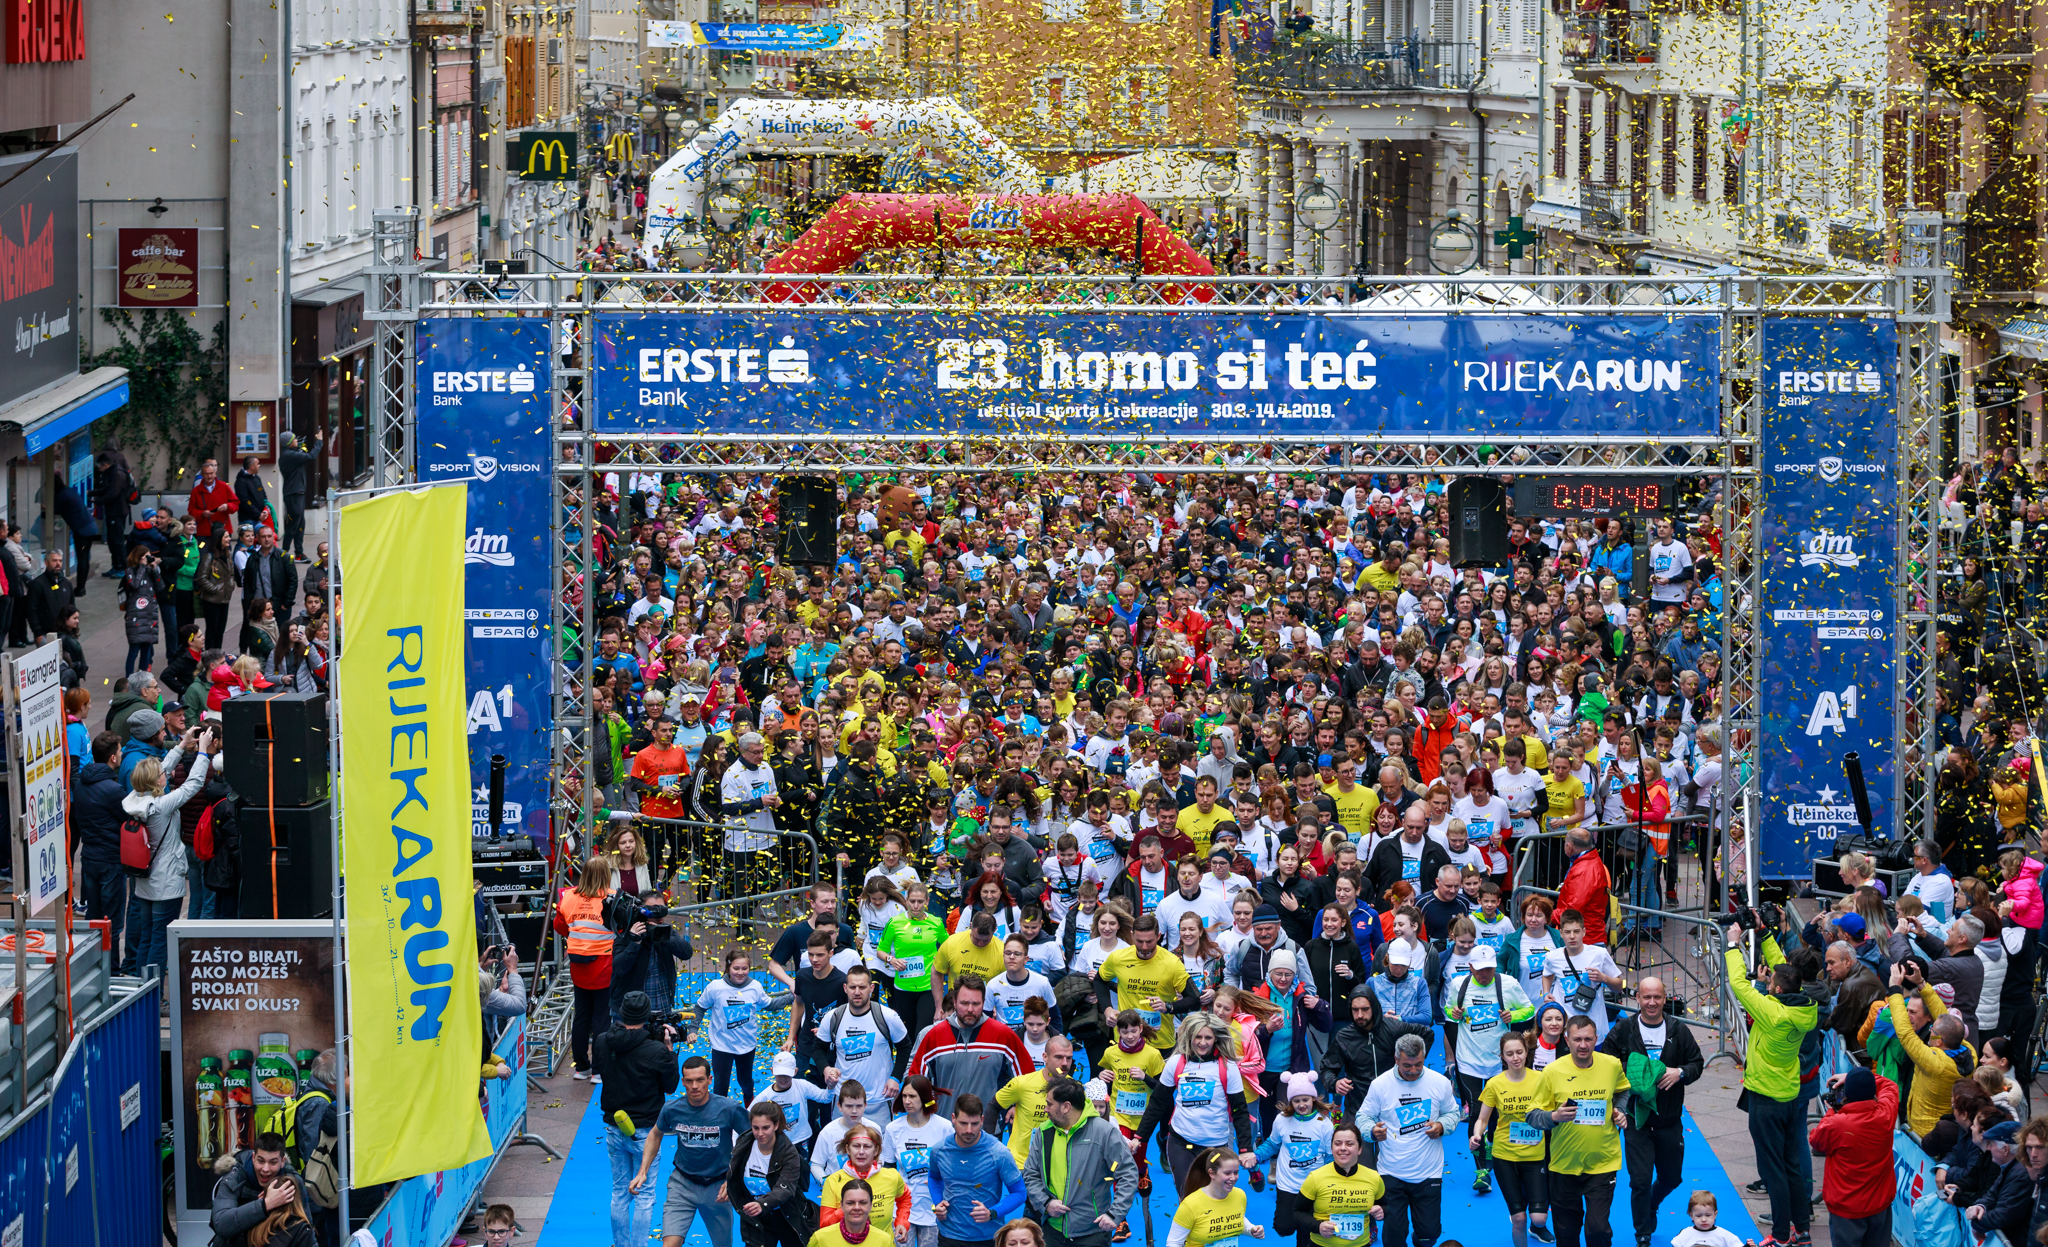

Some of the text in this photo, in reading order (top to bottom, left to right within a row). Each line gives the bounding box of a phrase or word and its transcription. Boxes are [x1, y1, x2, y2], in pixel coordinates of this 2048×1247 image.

[18, 0, 86, 63] RIJEKA
[761, 118, 845, 133] Heineken
[164, 245, 186, 258] bar
[639, 347, 760, 383] ERSTE
[937, 338, 1377, 390] 23. homo si teć
[433, 371, 506, 392] ERSTE
[1463, 359, 1682, 393] RIJEKARUN
[1779, 371, 1852, 392] ERSTE
[433, 395, 463, 406] Bank
[639, 387, 687, 407] Bank
[1779, 394, 1810, 406] Bank
[1046, 404, 1100, 422] sporta
[1114, 402, 1199, 421] rekreacije
[429, 463, 541, 472] SPORT VISION
[1774, 464, 1886, 472] SPORT VISION
[1553, 484, 1659, 509] 0:04:48
[465, 527, 509, 553] dm
[1809, 527, 1853, 553] dm
[1781, 610, 1869, 620] INTERSPAR
[483, 628, 521, 636] SPAR
[1827, 629, 1868, 637] SPAR
[26, 653, 57, 687] kamgrad
[466, 684, 513, 735] A1
[1805, 685, 1857, 736] A1
[386, 625, 454, 1042] RIJEKARUN
[191, 946, 304, 966] ZAŠTO BIRATI,
[191, 962, 289, 980] AKO MOŽEŠ
[191, 982, 259, 995] PROBATI
[191, 998, 300, 1011] SVAKI OKUS?
[396, 1006, 405, 1021] 42
[1518, 1095, 1532, 1103] you
[1573, 1088, 1607, 1097] not your
[1125, 1099, 1146, 1108] 1049
[1584, 1108, 1605, 1117] 1079
[1520, 1129, 1540, 1138] 1081
[1210, 1212, 1242, 1225] not your
[1340, 1221, 1363, 1231] 1139
[1209, 1225, 1222, 1233] PB
